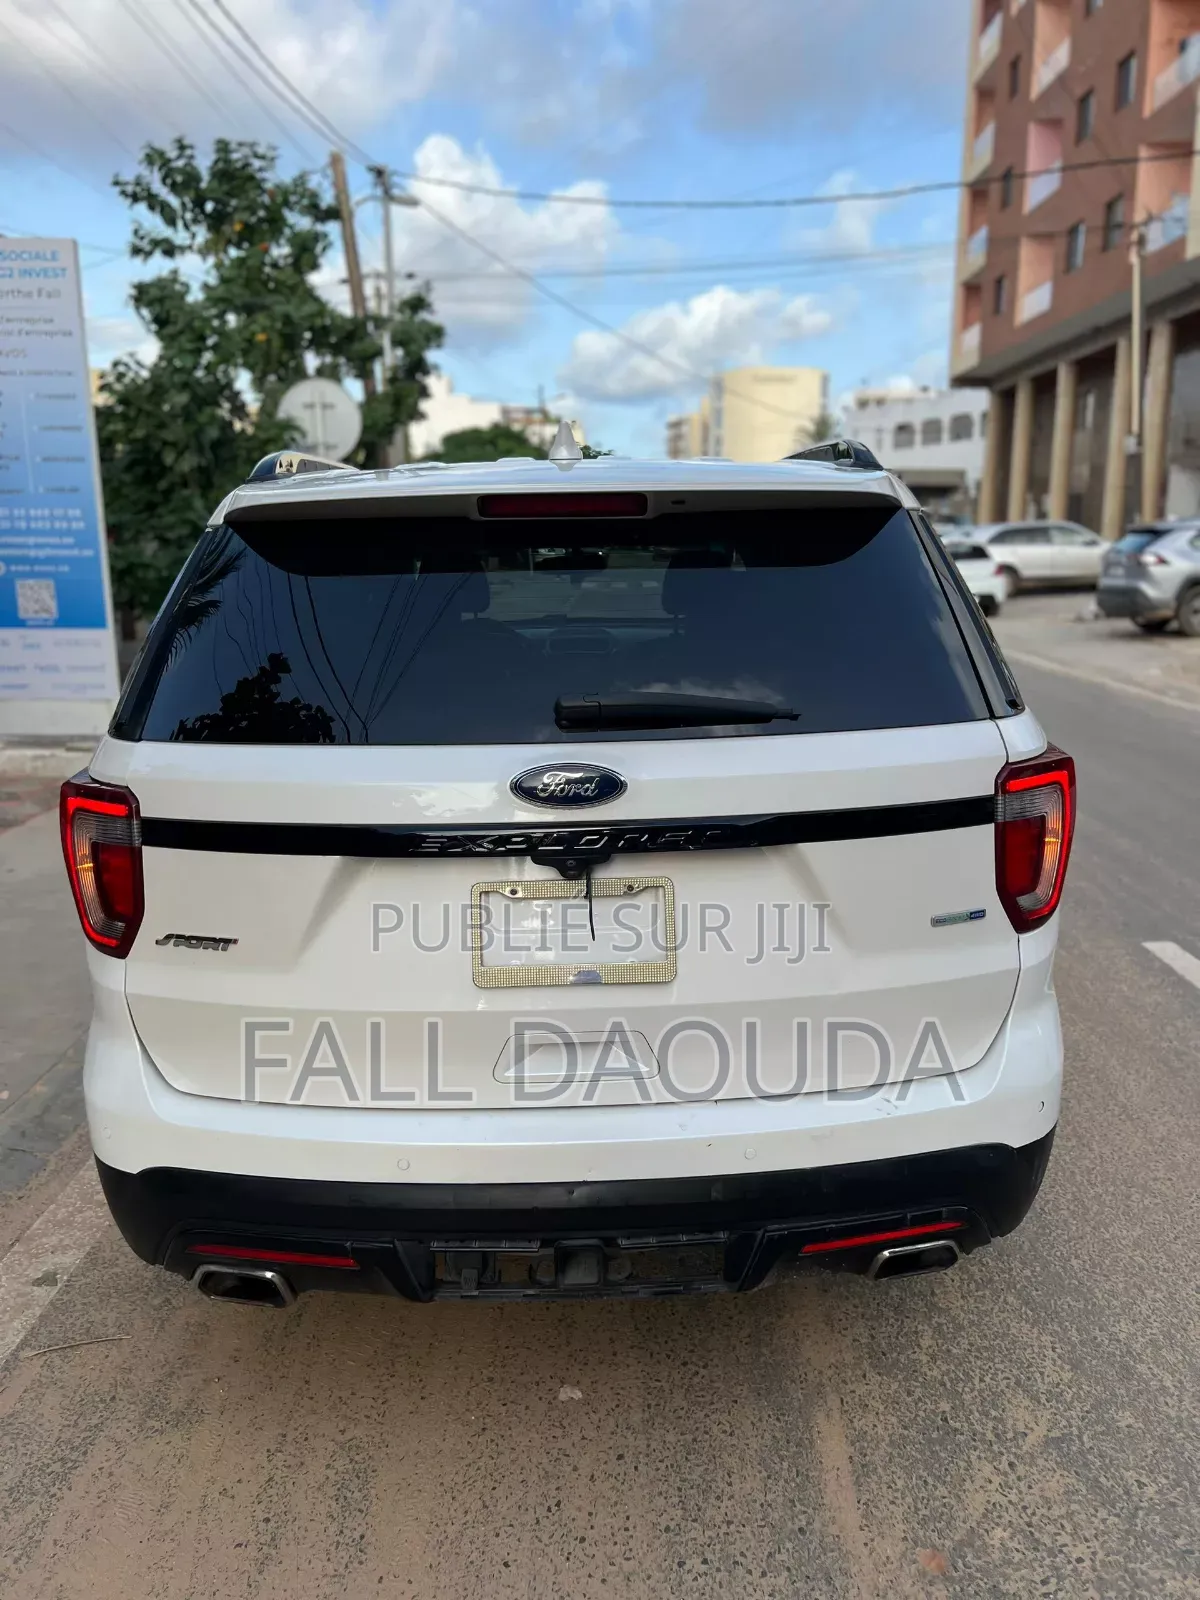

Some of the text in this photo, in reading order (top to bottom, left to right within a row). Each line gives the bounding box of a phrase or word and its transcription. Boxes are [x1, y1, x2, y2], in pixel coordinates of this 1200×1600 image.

[18, 267, 67, 279] INVEST
[537, 771, 600, 797] Ford
[155, 933, 237, 952] SPORT
